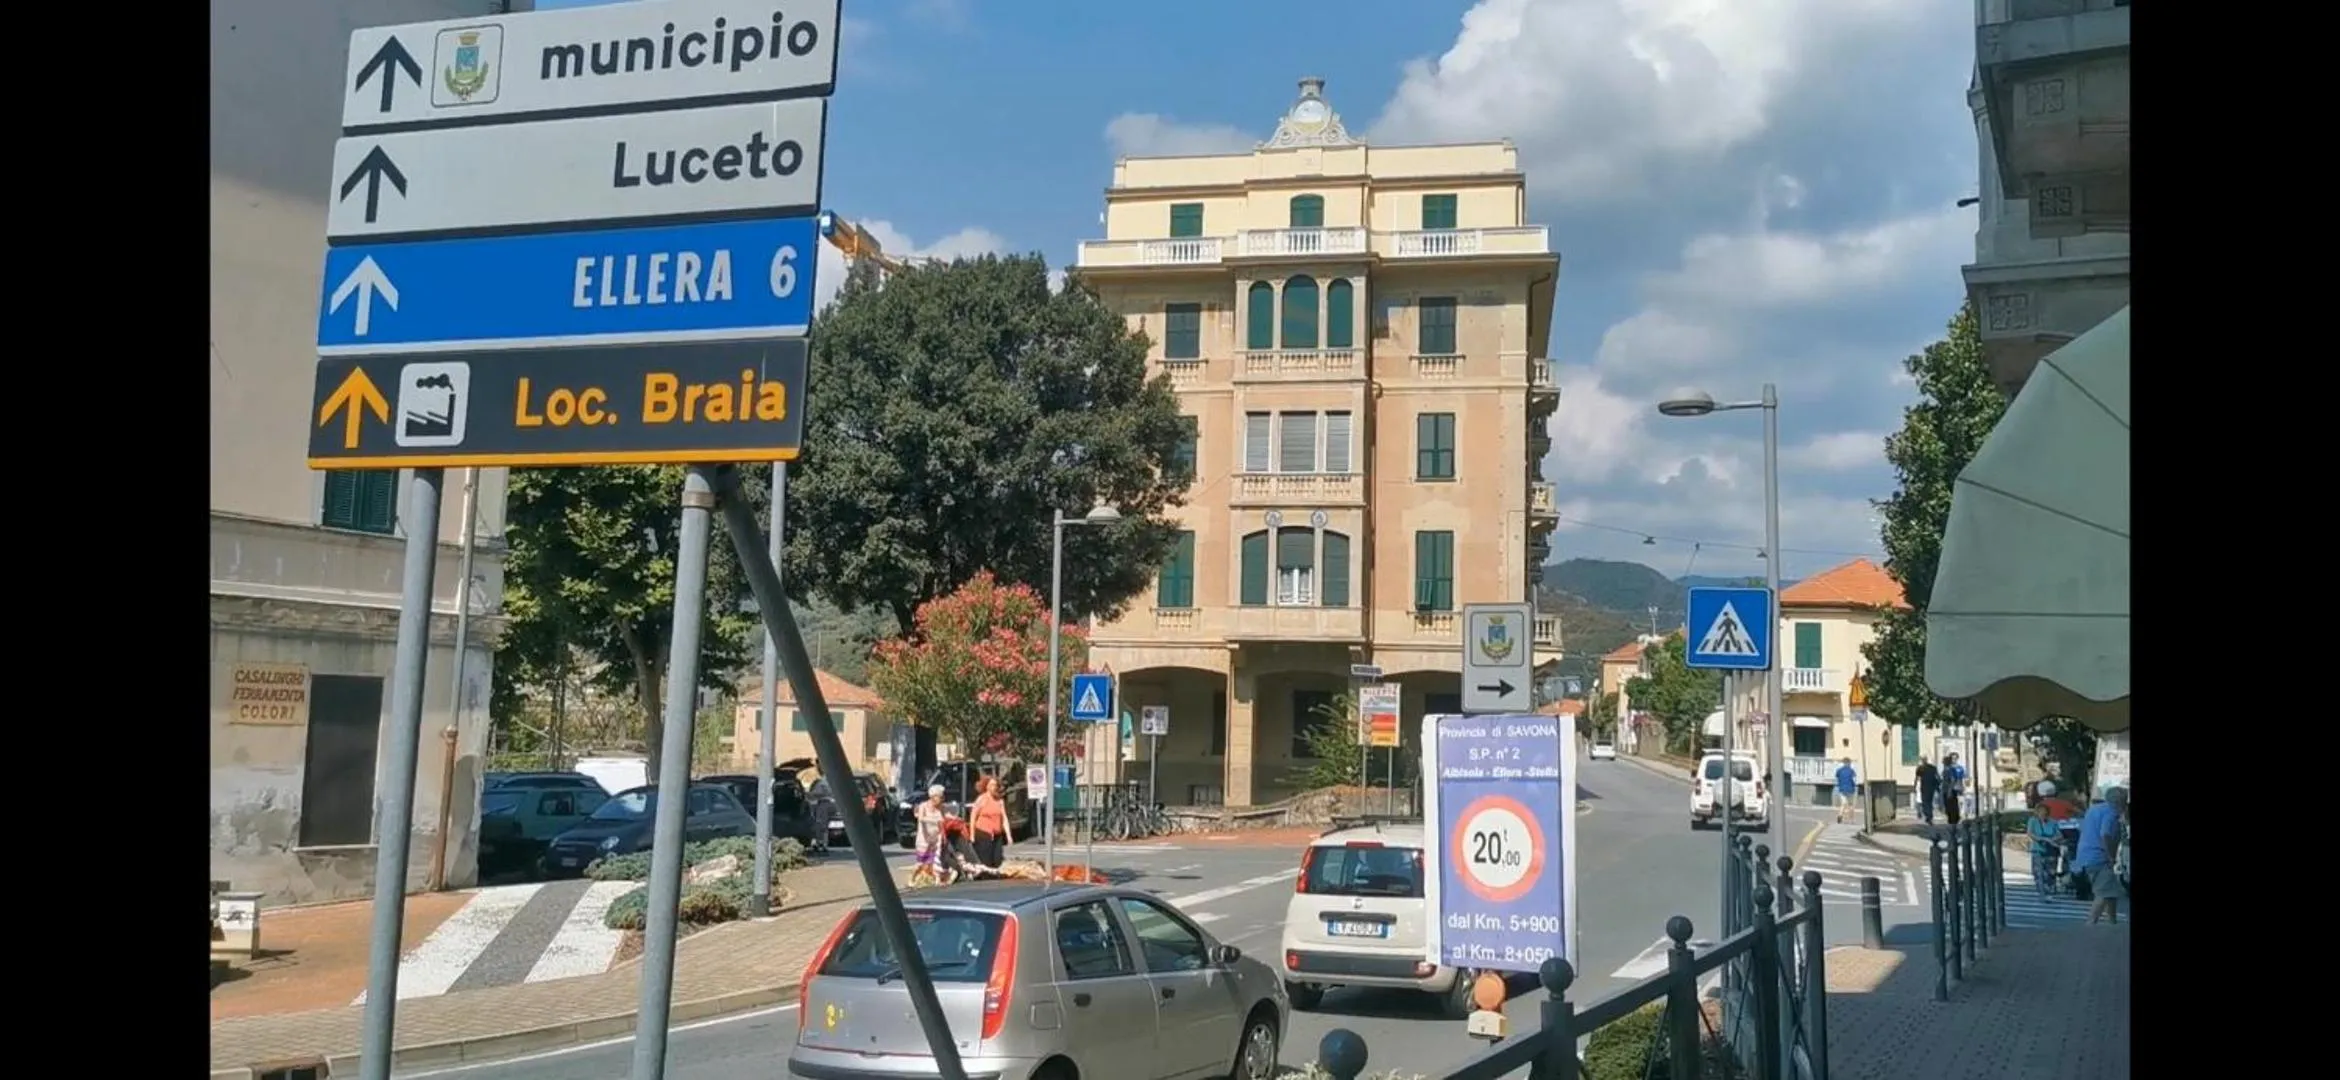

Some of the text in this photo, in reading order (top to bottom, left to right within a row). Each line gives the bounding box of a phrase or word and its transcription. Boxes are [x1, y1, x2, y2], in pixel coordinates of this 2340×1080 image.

[541, 11, 819, 80] municipio
[613, 131, 803, 187] Luceto
[573, 245, 798, 307] ELLERA 6
[515, 369, 787, 426] Loc. Braia
[240, 703, 296, 719] COLORI
[1440, 723, 1558, 738] Provincia di SAVONA
[1469, 746, 1494, 760] S.P.
[1511, 746, 1521, 760] 2
[1447, 912, 1560, 933] dal Km. 5+900
[1452, 944, 1466, 960] al
[1470, 943, 1501, 961] Km.
